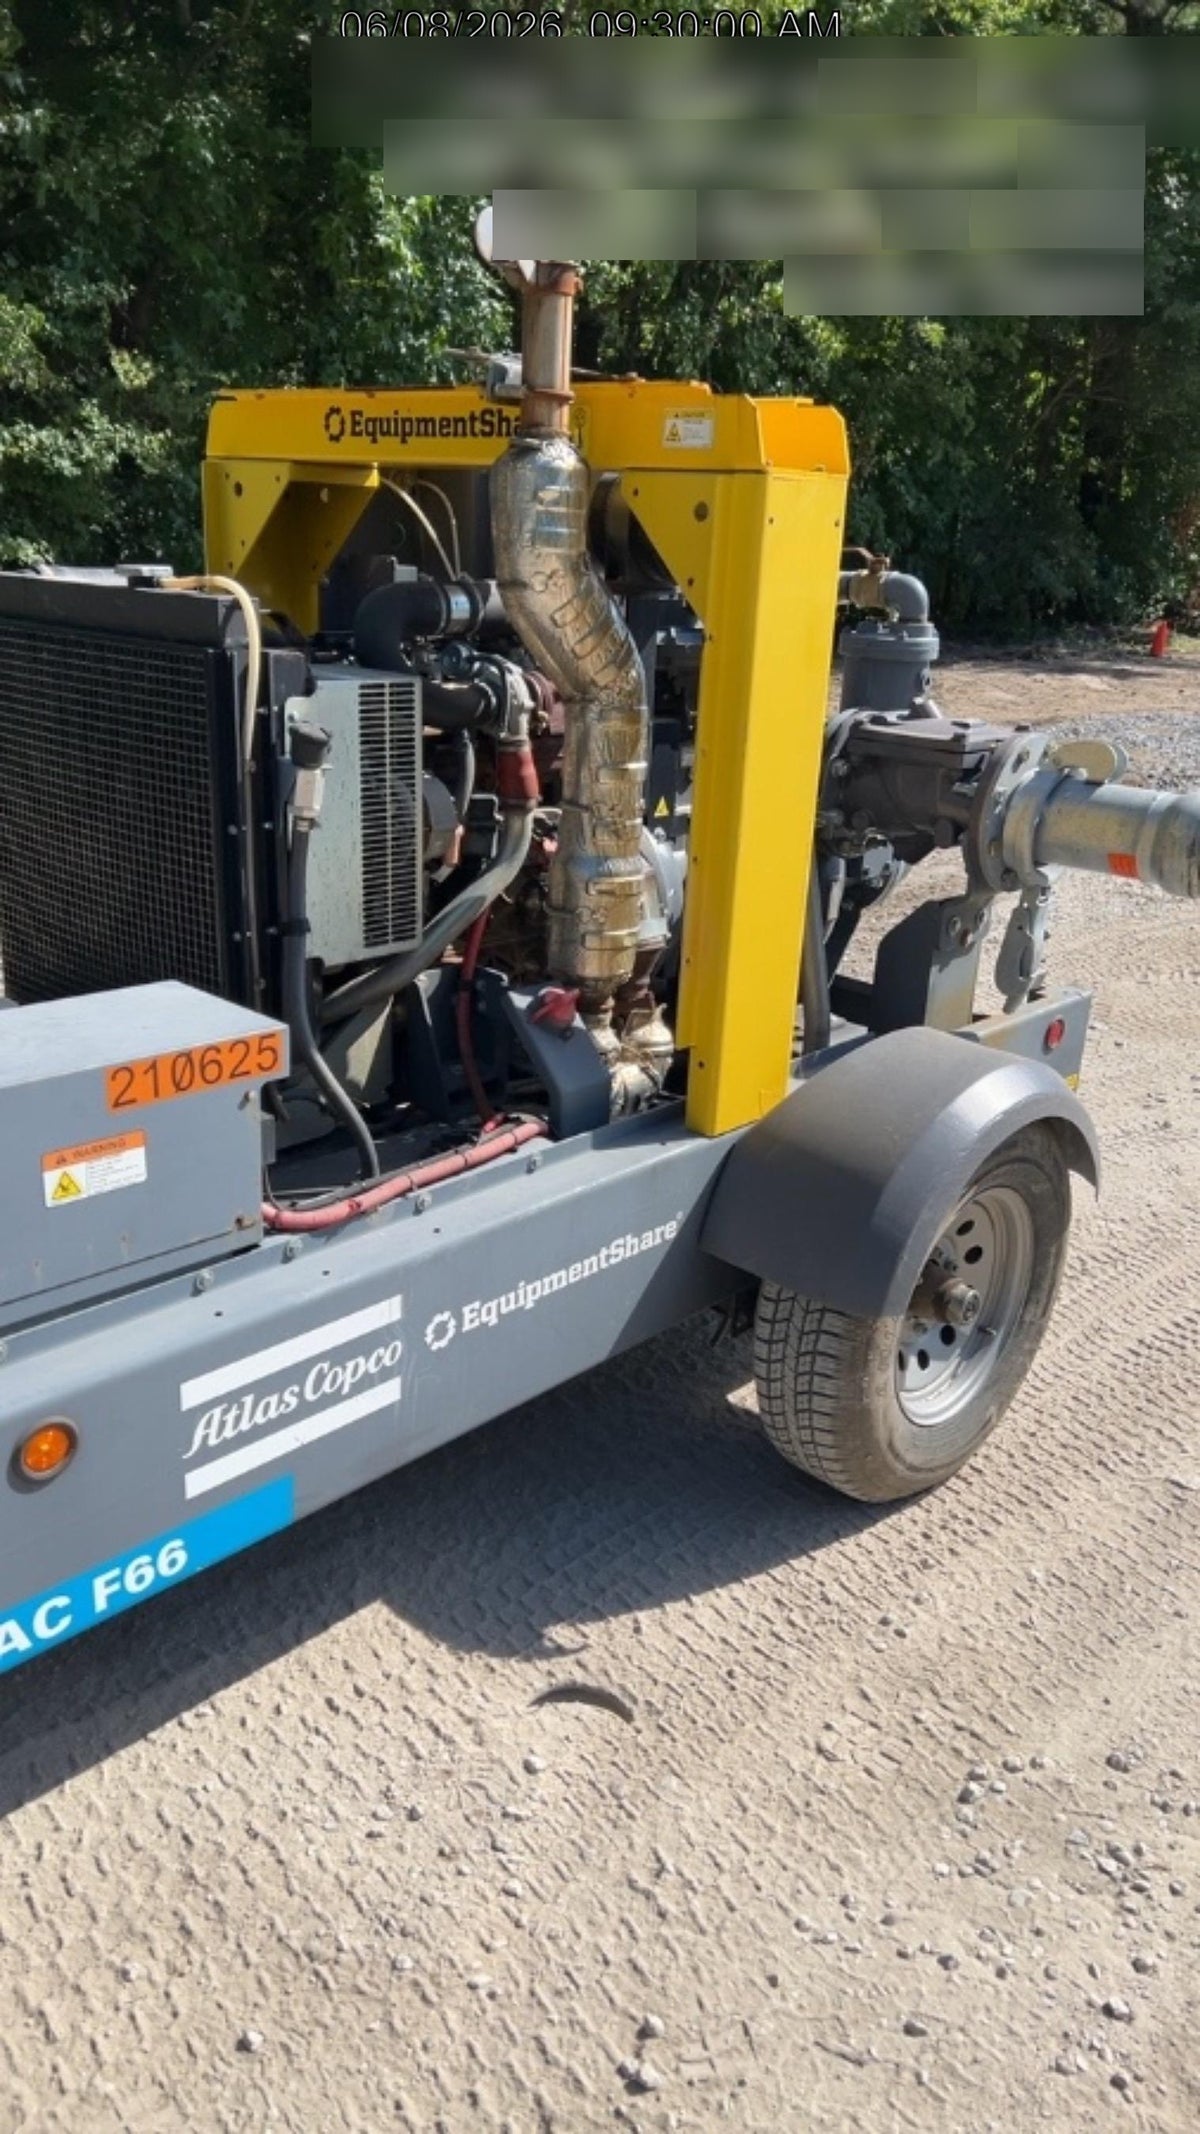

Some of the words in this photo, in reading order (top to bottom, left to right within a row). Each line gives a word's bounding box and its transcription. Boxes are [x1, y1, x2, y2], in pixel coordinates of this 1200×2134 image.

[110, 1033, 279, 1109] 210625
[182, 1384, 300, 1459] Atlas
[303, 1340, 402, 1402] Copco
[0, 1595, 72, 1657] AC
[92, 1538, 188, 1614] F66
